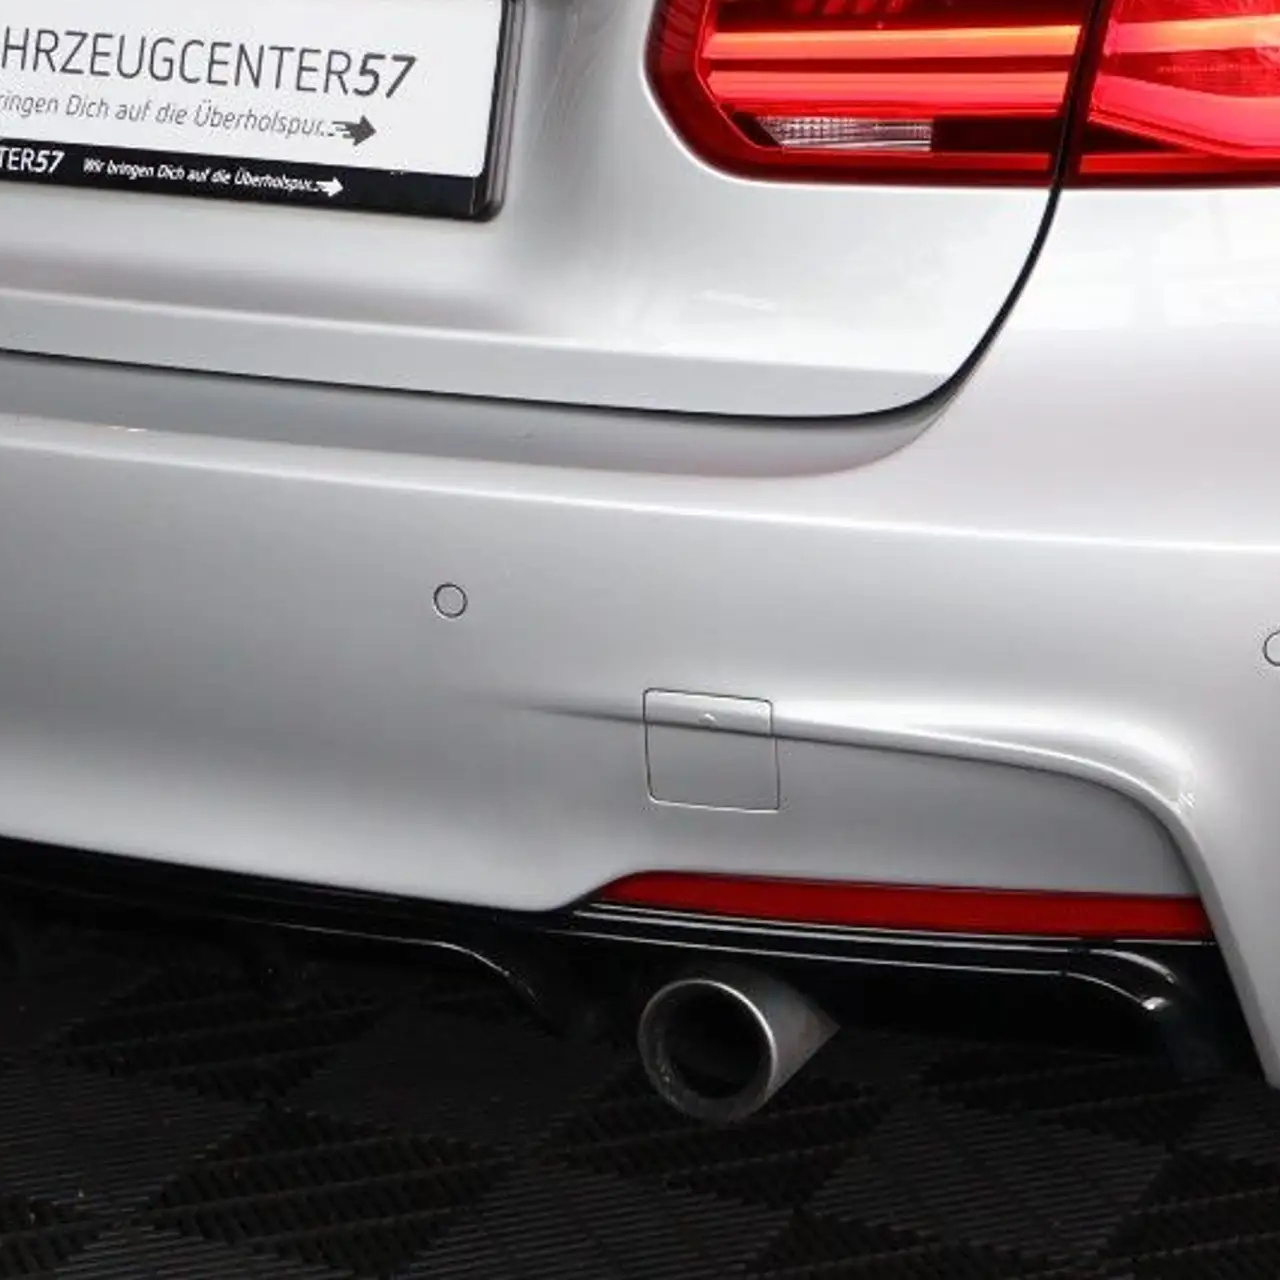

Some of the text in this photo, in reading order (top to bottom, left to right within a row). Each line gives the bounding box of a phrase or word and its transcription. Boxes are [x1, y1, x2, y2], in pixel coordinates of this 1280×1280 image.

[65, 94, 109, 120] Dich
[114, 99, 152, 122] auf
[155, 103, 188, 126] die
[83, 158, 106, 173] Wir
[107, 160, 154, 180] bringen
